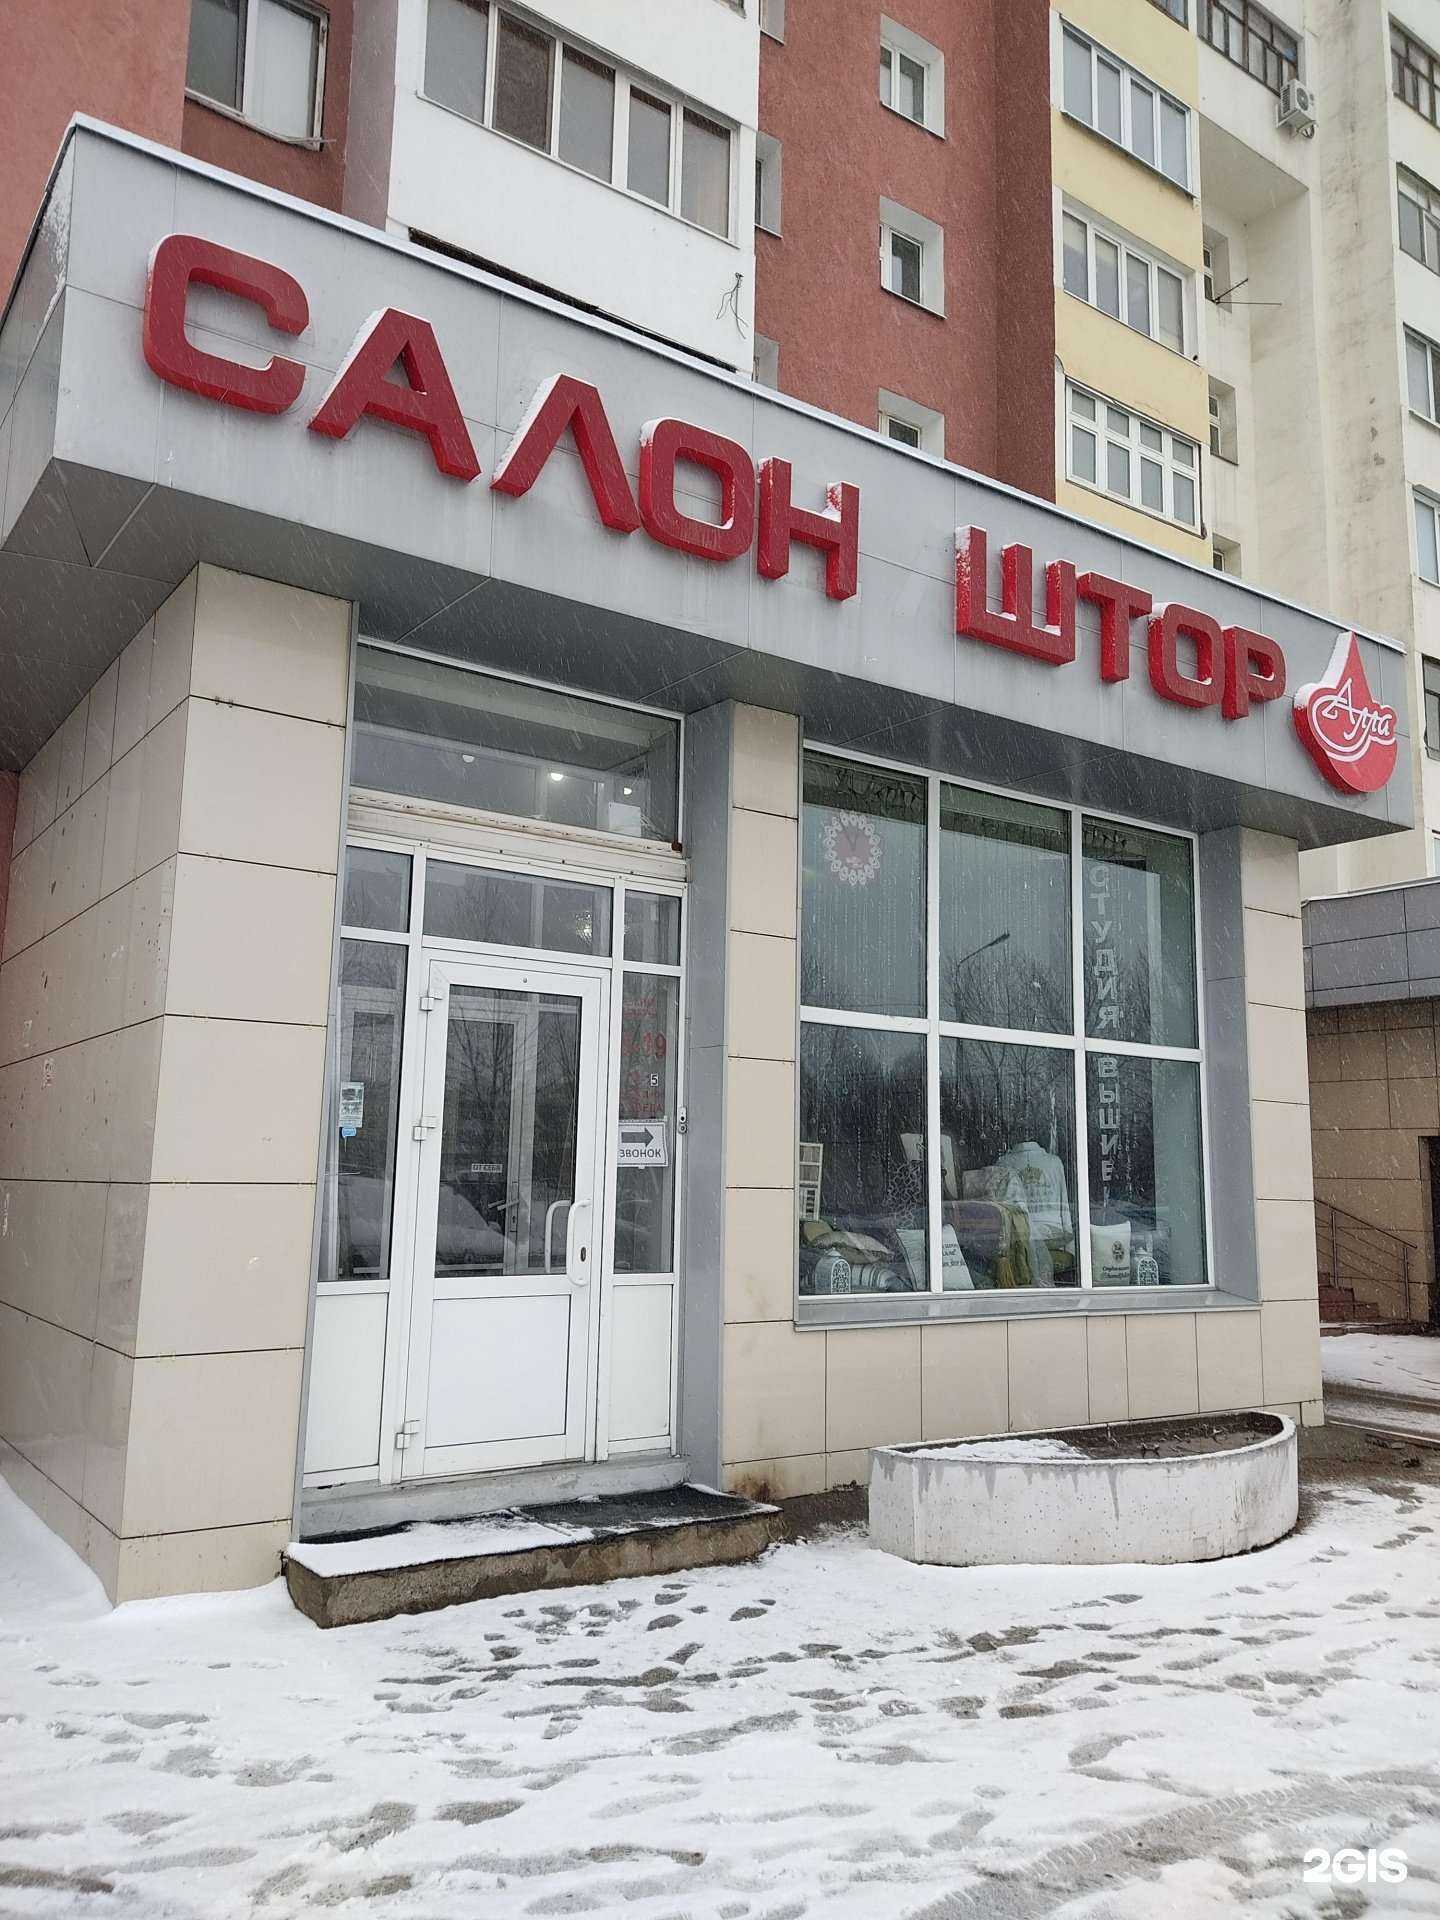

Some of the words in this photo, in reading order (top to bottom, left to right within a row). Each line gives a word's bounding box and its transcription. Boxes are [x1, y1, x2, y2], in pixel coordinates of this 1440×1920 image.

[142, 234, 860, 600] САЛОН
[955, 525, 1287, 720] ШТОР
[1088, 865, 1121, 1030] СТУДИЯ
[651, 1074, 658, 1085] 5
[619, 1148, 662, 1158] ЗВОНОК
